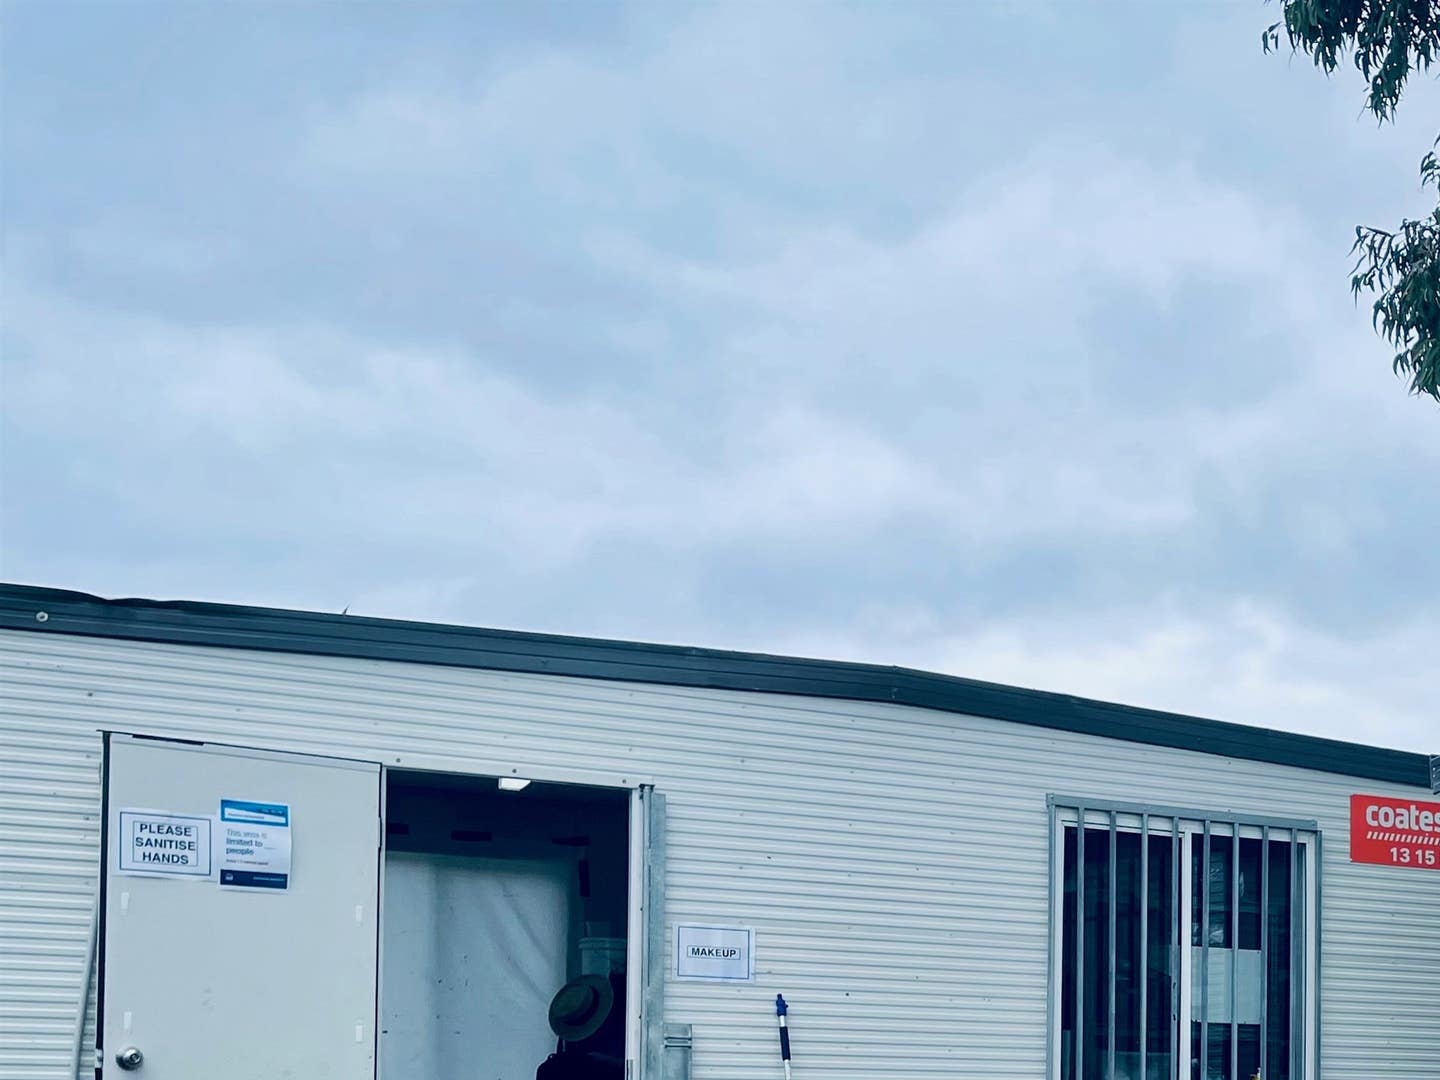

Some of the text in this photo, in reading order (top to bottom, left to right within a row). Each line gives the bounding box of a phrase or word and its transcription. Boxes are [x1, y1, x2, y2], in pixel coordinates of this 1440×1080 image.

[140, 823, 192, 837] PLEASE
[135, 837, 196, 851] SANITISE
[226, 837, 263, 848] limited to
[226, 847, 254, 855] people
[1390, 847, 1410, 863] 13
[1415, 849, 1435, 865] 15
[142, 852, 189, 865] HANDS
[691, 947, 737, 958] MAKEUP
